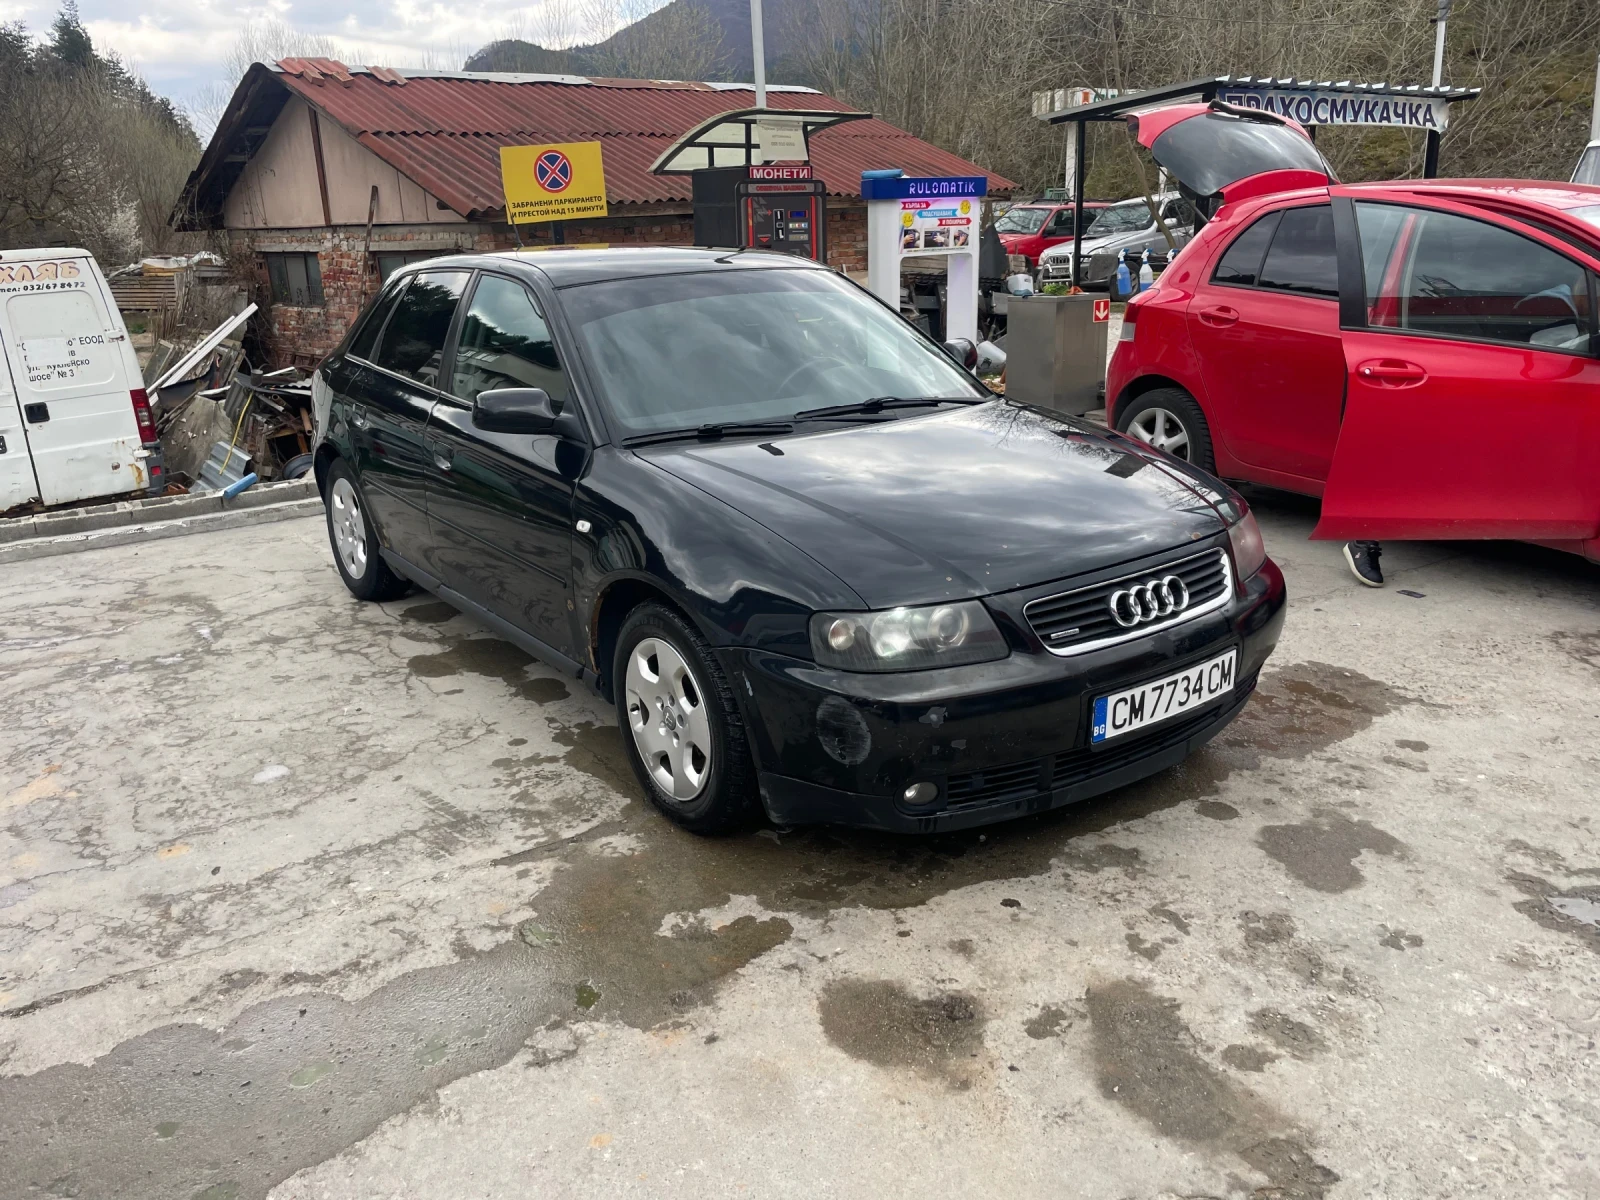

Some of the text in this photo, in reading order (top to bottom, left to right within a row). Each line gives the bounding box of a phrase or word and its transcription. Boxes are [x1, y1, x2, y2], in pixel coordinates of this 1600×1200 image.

[1226, 93, 1437, 128] ПРАХОСМУКАЧКА
[752, 168, 808, 179] МОНЕТИ
[909, 181, 975, 194] RULOMATIK
[511, 195, 602, 209] ЗАБРАНЕНИ ПАРКИРАНЕТО
[518, 208, 550, 218] ПРЕСТОЙ
[551, 207, 566, 216] НАД
[575, 204, 604, 213] МИНУТИ
[79, 334, 105, 345] ЕООД
[57, 370, 67, 379] №
[69, 368, 75, 377] 3
[1093, 724, 1105, 736] BG
